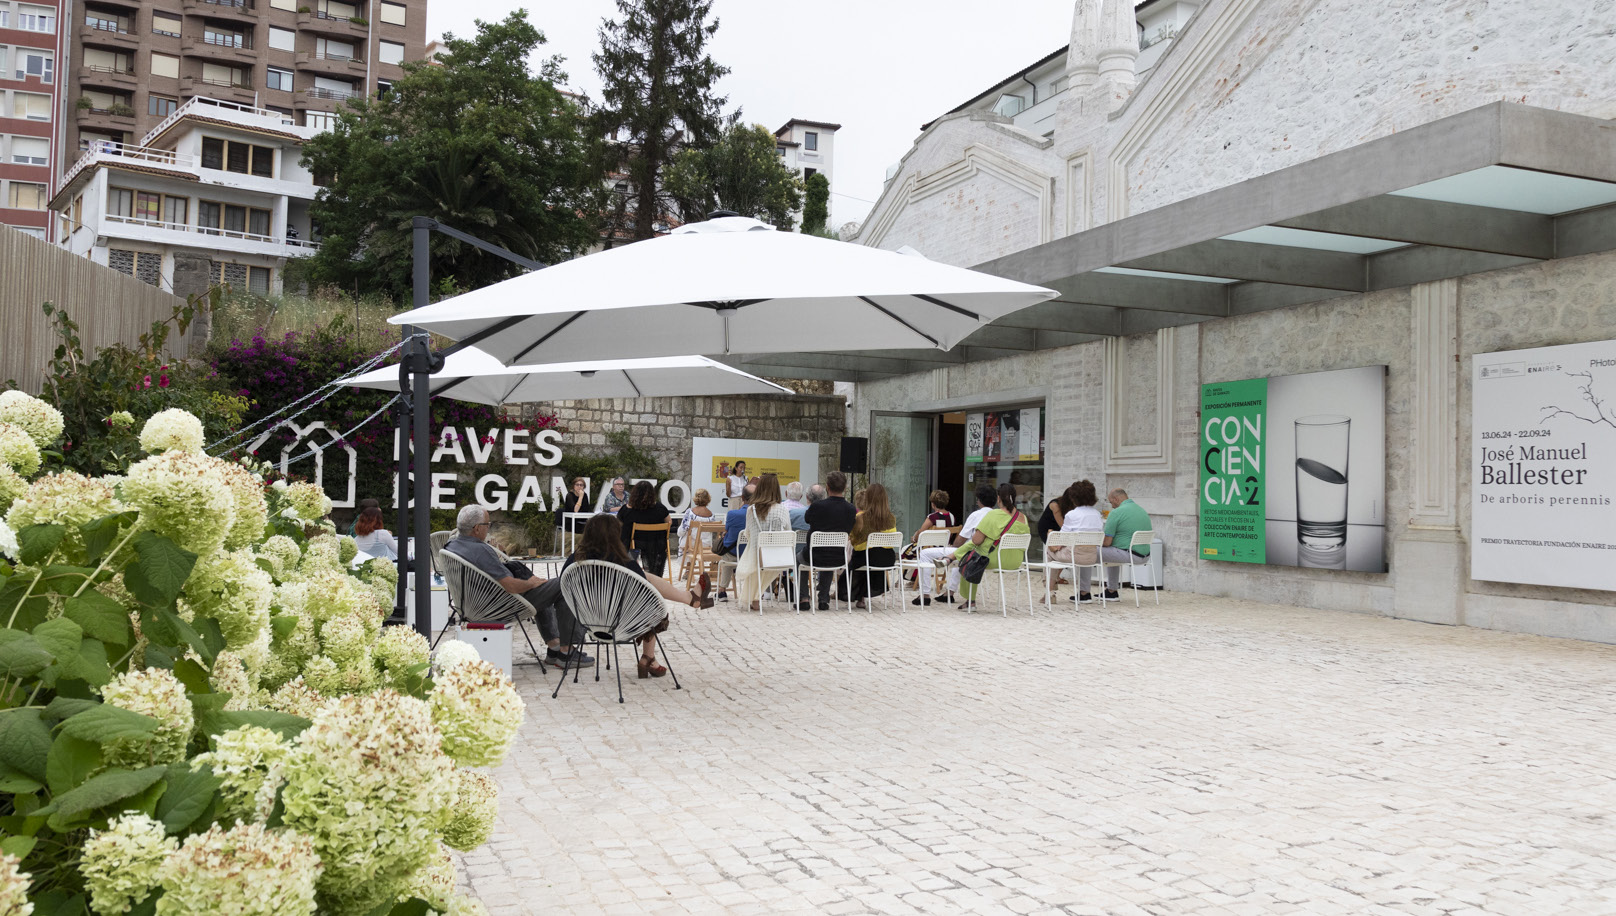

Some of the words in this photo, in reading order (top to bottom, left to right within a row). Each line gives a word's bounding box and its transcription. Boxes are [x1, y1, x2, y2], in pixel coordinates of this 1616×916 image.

[1205, 401, 1231, 410] EXPOSICIÓN
[1232, 400, 1262, 408] PERMANENTE
[1205, 414, 1261, 445] CON
[1481, 431, 1512, 439] 13.06.24
[1518, 429, 1551, 438] 22.09.24
[1204, 444, 1260, 475] CIEN
[1481, 444, 1515, 465] José
[1519, 442, 1587, 461] Manuel
[1480, 462, 1588, 486] Ballester
[474, 474, 692, 514] GAMO
[1480, 494, 1495, 504] De
[1499, 494, 1545, 504] arboris
[1550, 494, 1611, 506] perennis
[1216, 532, 1259, 540] CONTEMPORÁNEO
